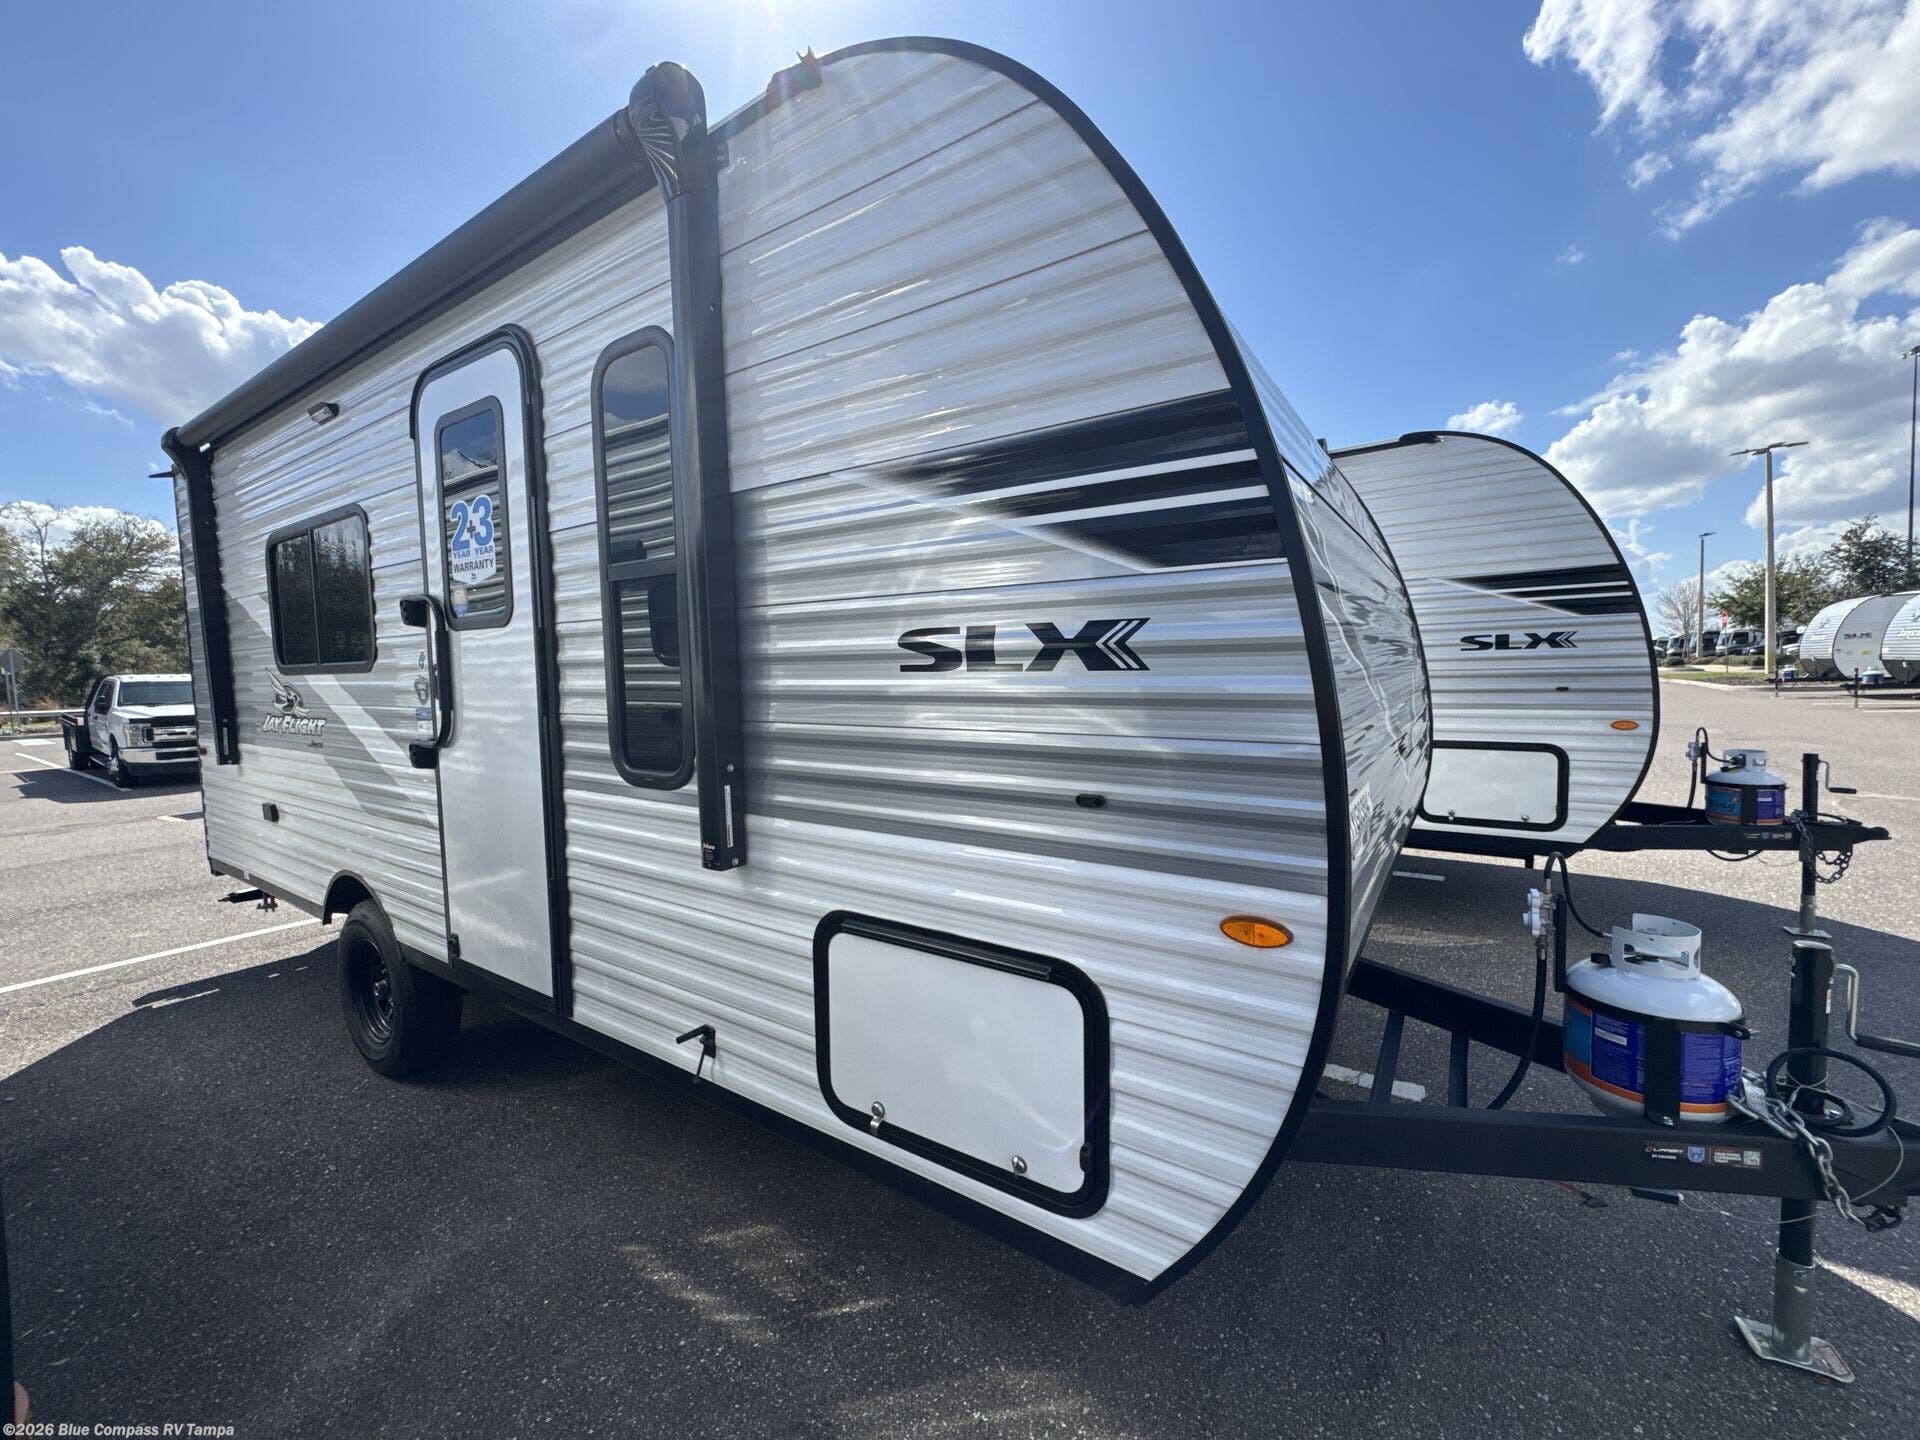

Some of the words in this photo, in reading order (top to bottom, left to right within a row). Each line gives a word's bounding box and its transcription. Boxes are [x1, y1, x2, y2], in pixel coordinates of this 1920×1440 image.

[453, 550, 471, 559] YEAR
[475, 546, 494, 555] YEAR
[453, 558, 495, 573] WARRANTY
[898, 617, 1151, 672] SLX
[1460, 631, 1578, 651] SLX
[262, 713, 284, 733] JAY
[282, 715, 327, 737] FLIGHT
